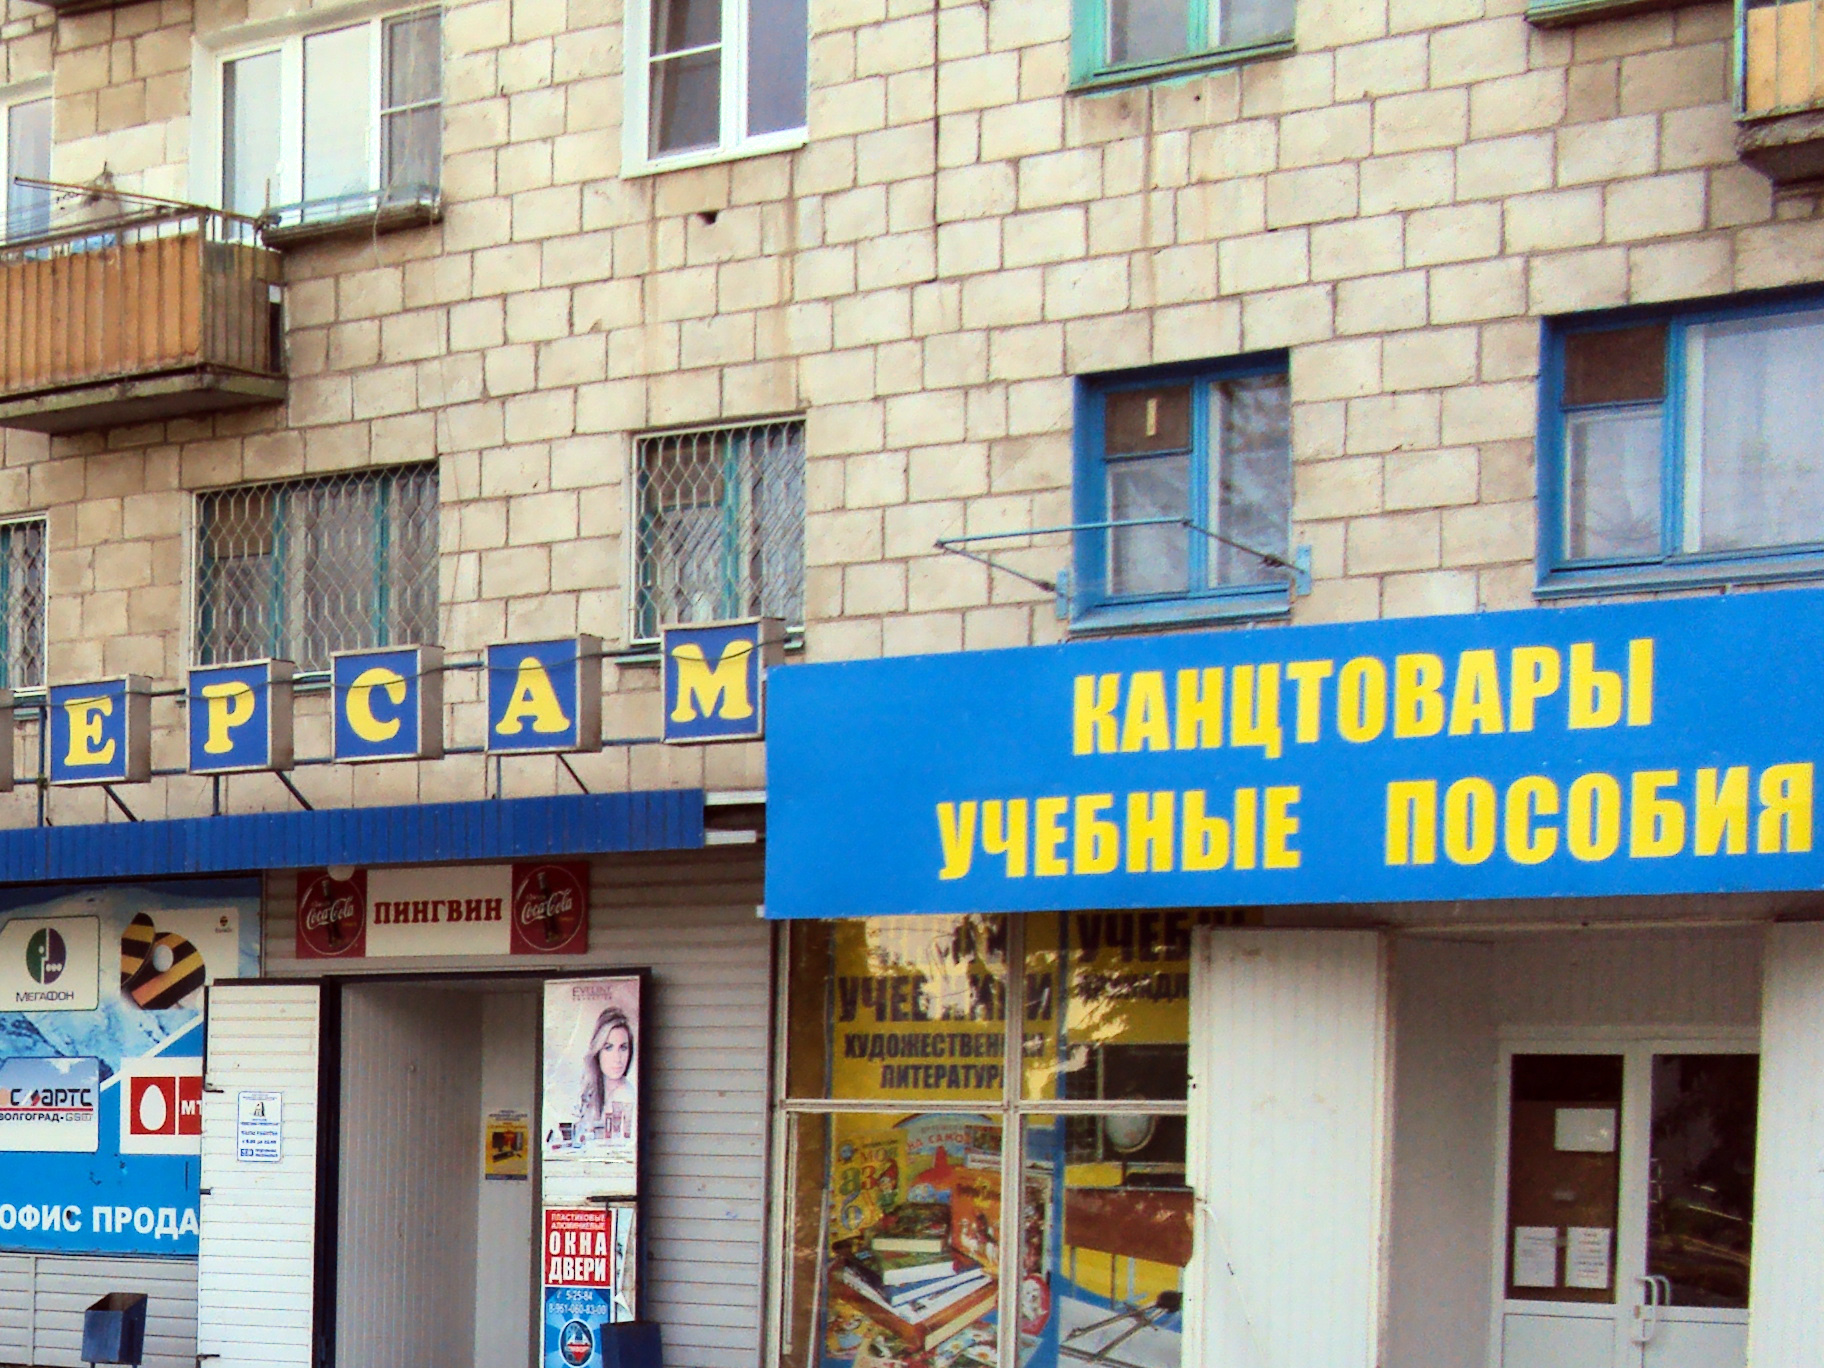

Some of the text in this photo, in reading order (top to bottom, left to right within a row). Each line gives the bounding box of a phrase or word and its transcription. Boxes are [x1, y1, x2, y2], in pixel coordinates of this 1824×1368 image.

[1071, 637, 1656, 759] КАНЦТОВАРЫ
[936, 761, 1816, 882] УЧЕБНЫЕ ПОСОБИЯ
[306, 895, 355, 931] Coca-Cola
[373, 898, 503, 925] ПИНГВИН
[521, 887, 573, 926] Coca-Cola
[1077, 911, 1243, 962] УЧЕБ
[880, 1063, 1005, 1091] ЛИТЕРАТУР
[549, 1231, 607, 1256] ОКНА
[548, 1256, 607, 1285] ДВЕРИ
